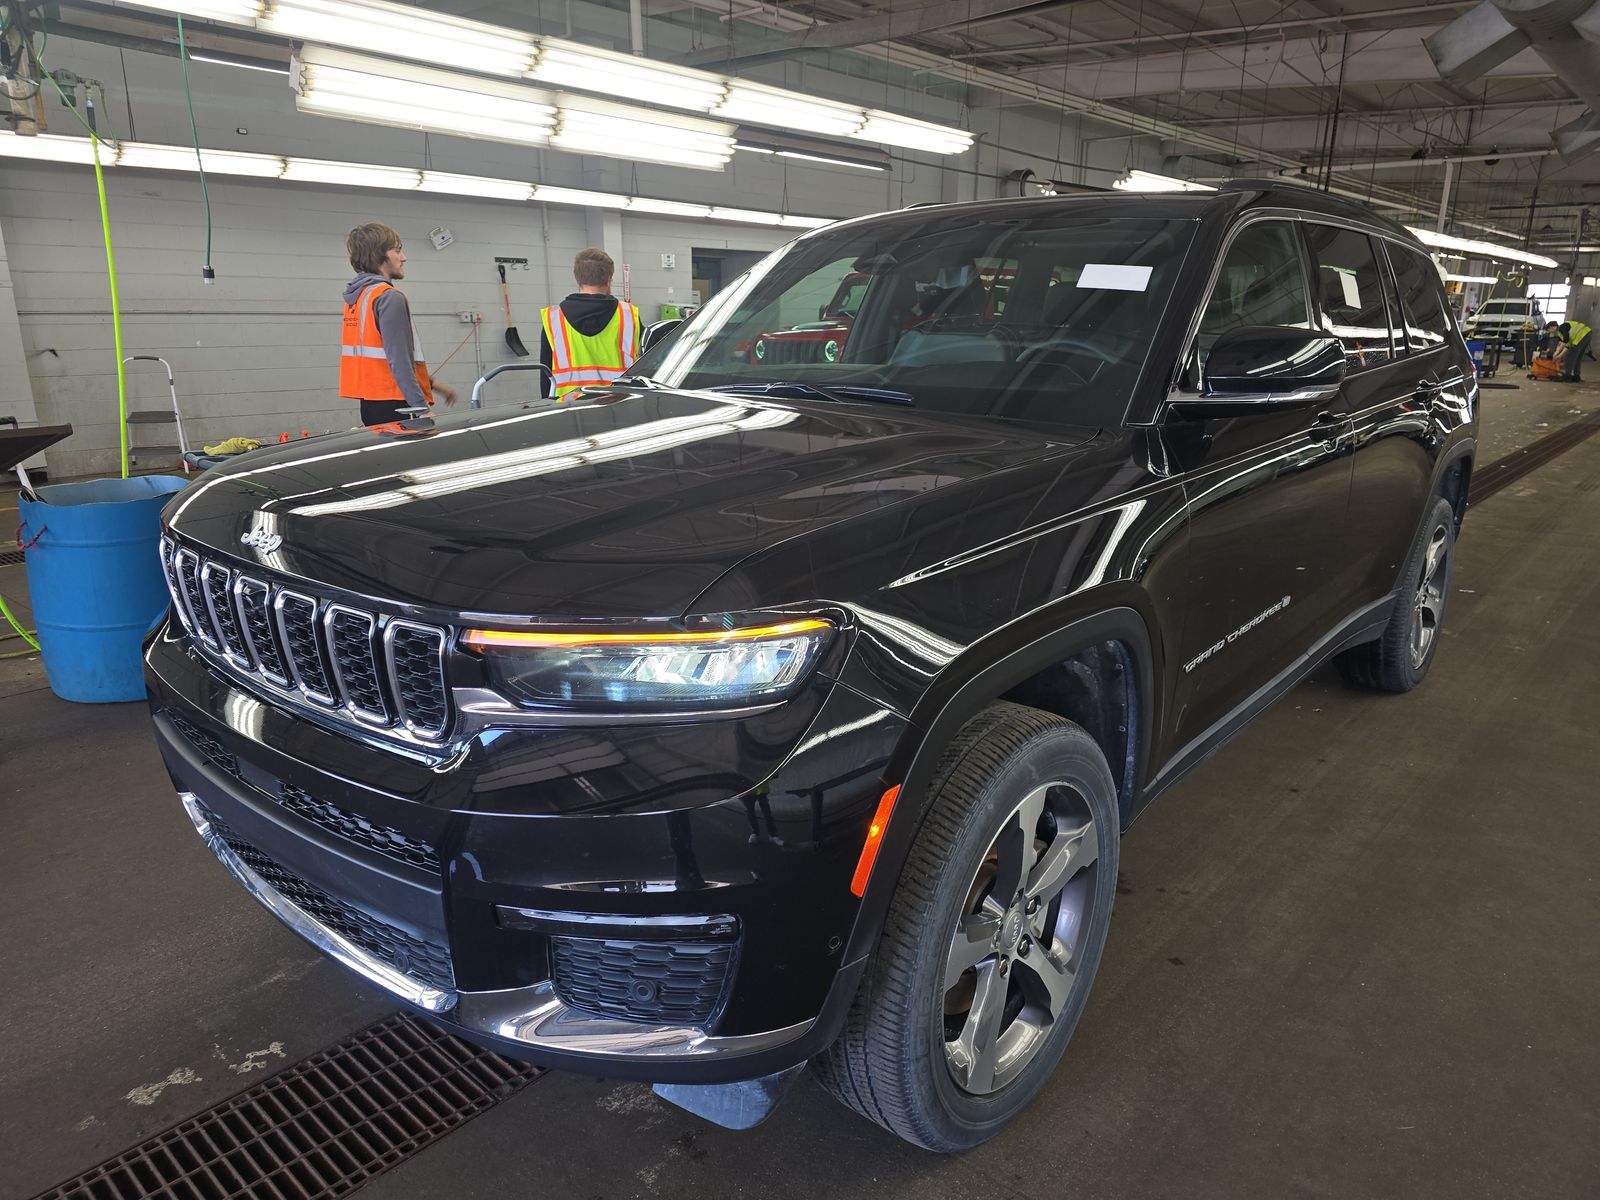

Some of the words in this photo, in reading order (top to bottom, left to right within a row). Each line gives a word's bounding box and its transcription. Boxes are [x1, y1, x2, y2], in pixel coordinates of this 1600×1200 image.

[241, 523, 283, 556] Jeep
[1184, 639, 1226, 673] GRAND
[1226, 602, 1283, 644] CHEROKEE
